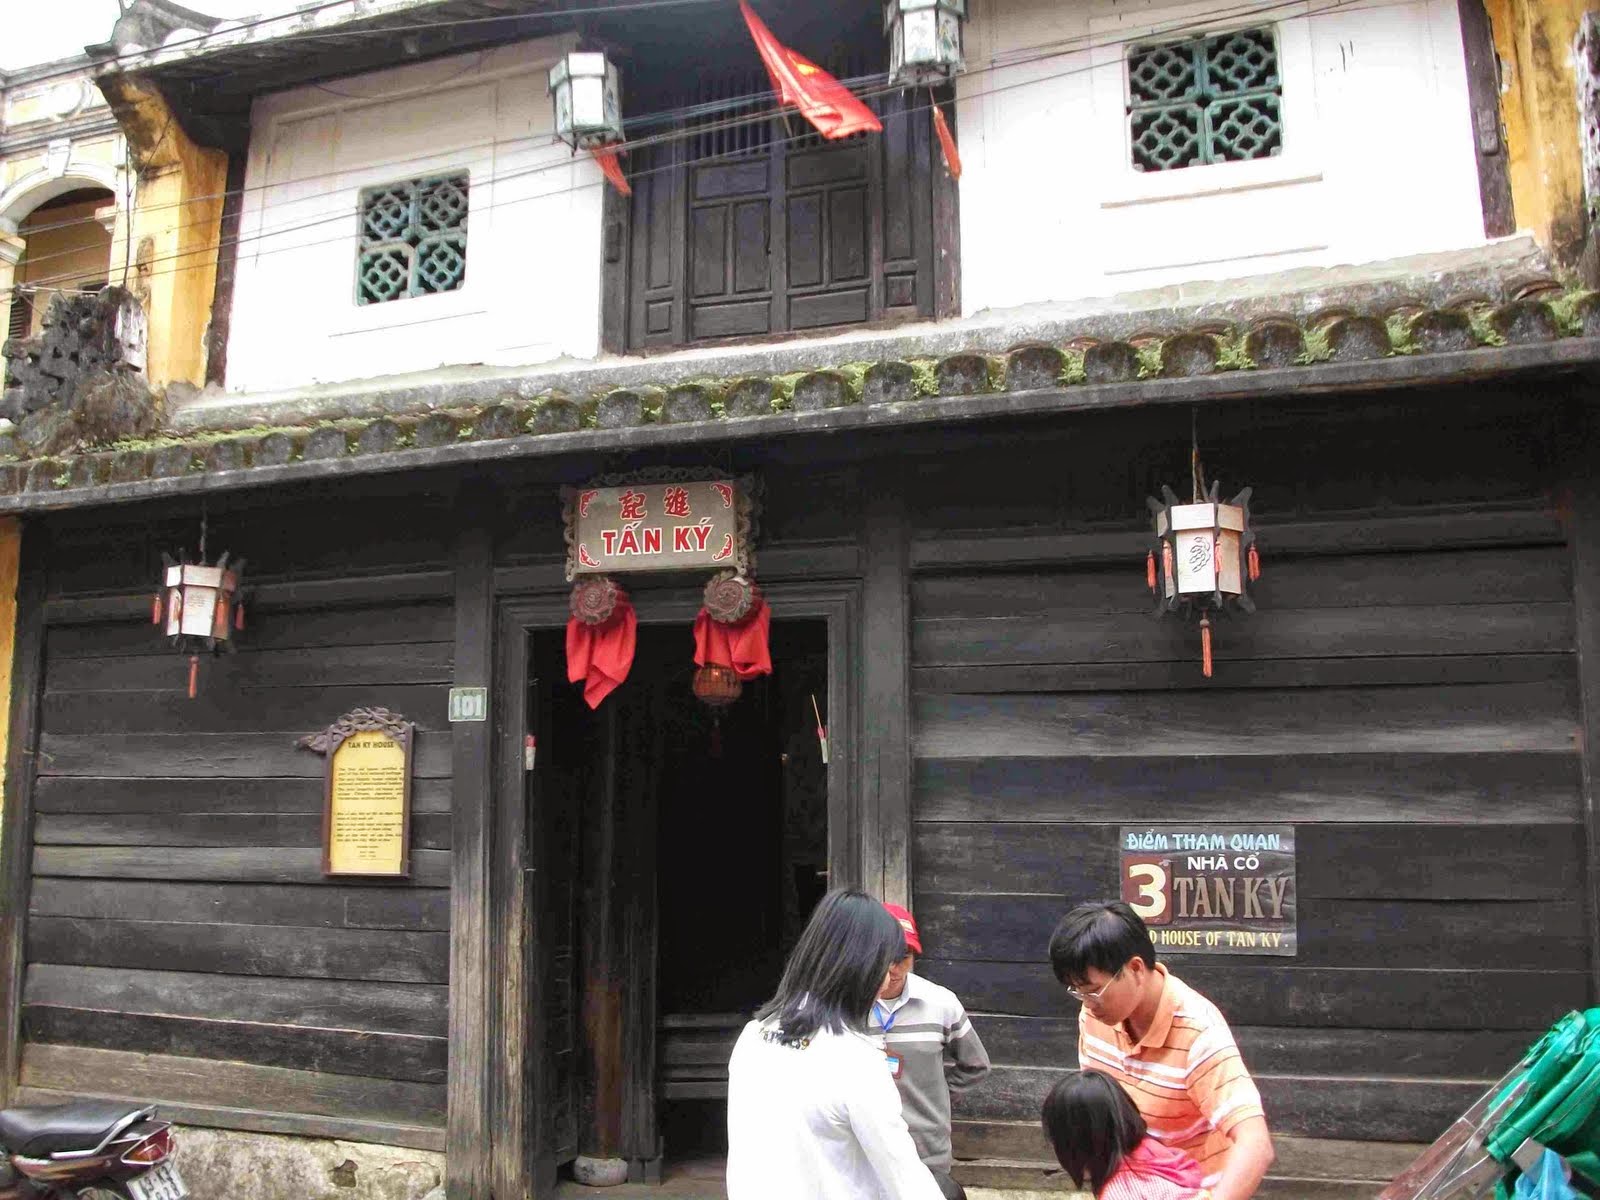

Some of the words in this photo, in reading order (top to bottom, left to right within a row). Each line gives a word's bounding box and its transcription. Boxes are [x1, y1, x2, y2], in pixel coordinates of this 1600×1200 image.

[600, 520, 663, 556] TẤN
[672, 516, 714, 552] KÝ
[453, 694, 482, 717] 101
[362, 741, 371, 749] KY
[372, 741, 394, 749] HOUSE
[1172, 833, 1226, 850] THAM
[1230, 833, 1281, 852] QUAN
[1233, 851, 1260, 870] CỔ
[1129, 863, 1167, 918] 3
[1161, 930, 1202, 946] HOUSE
[1205, 931, 1222, 946] OF
[1226, 931, 1256, 948] TAN
